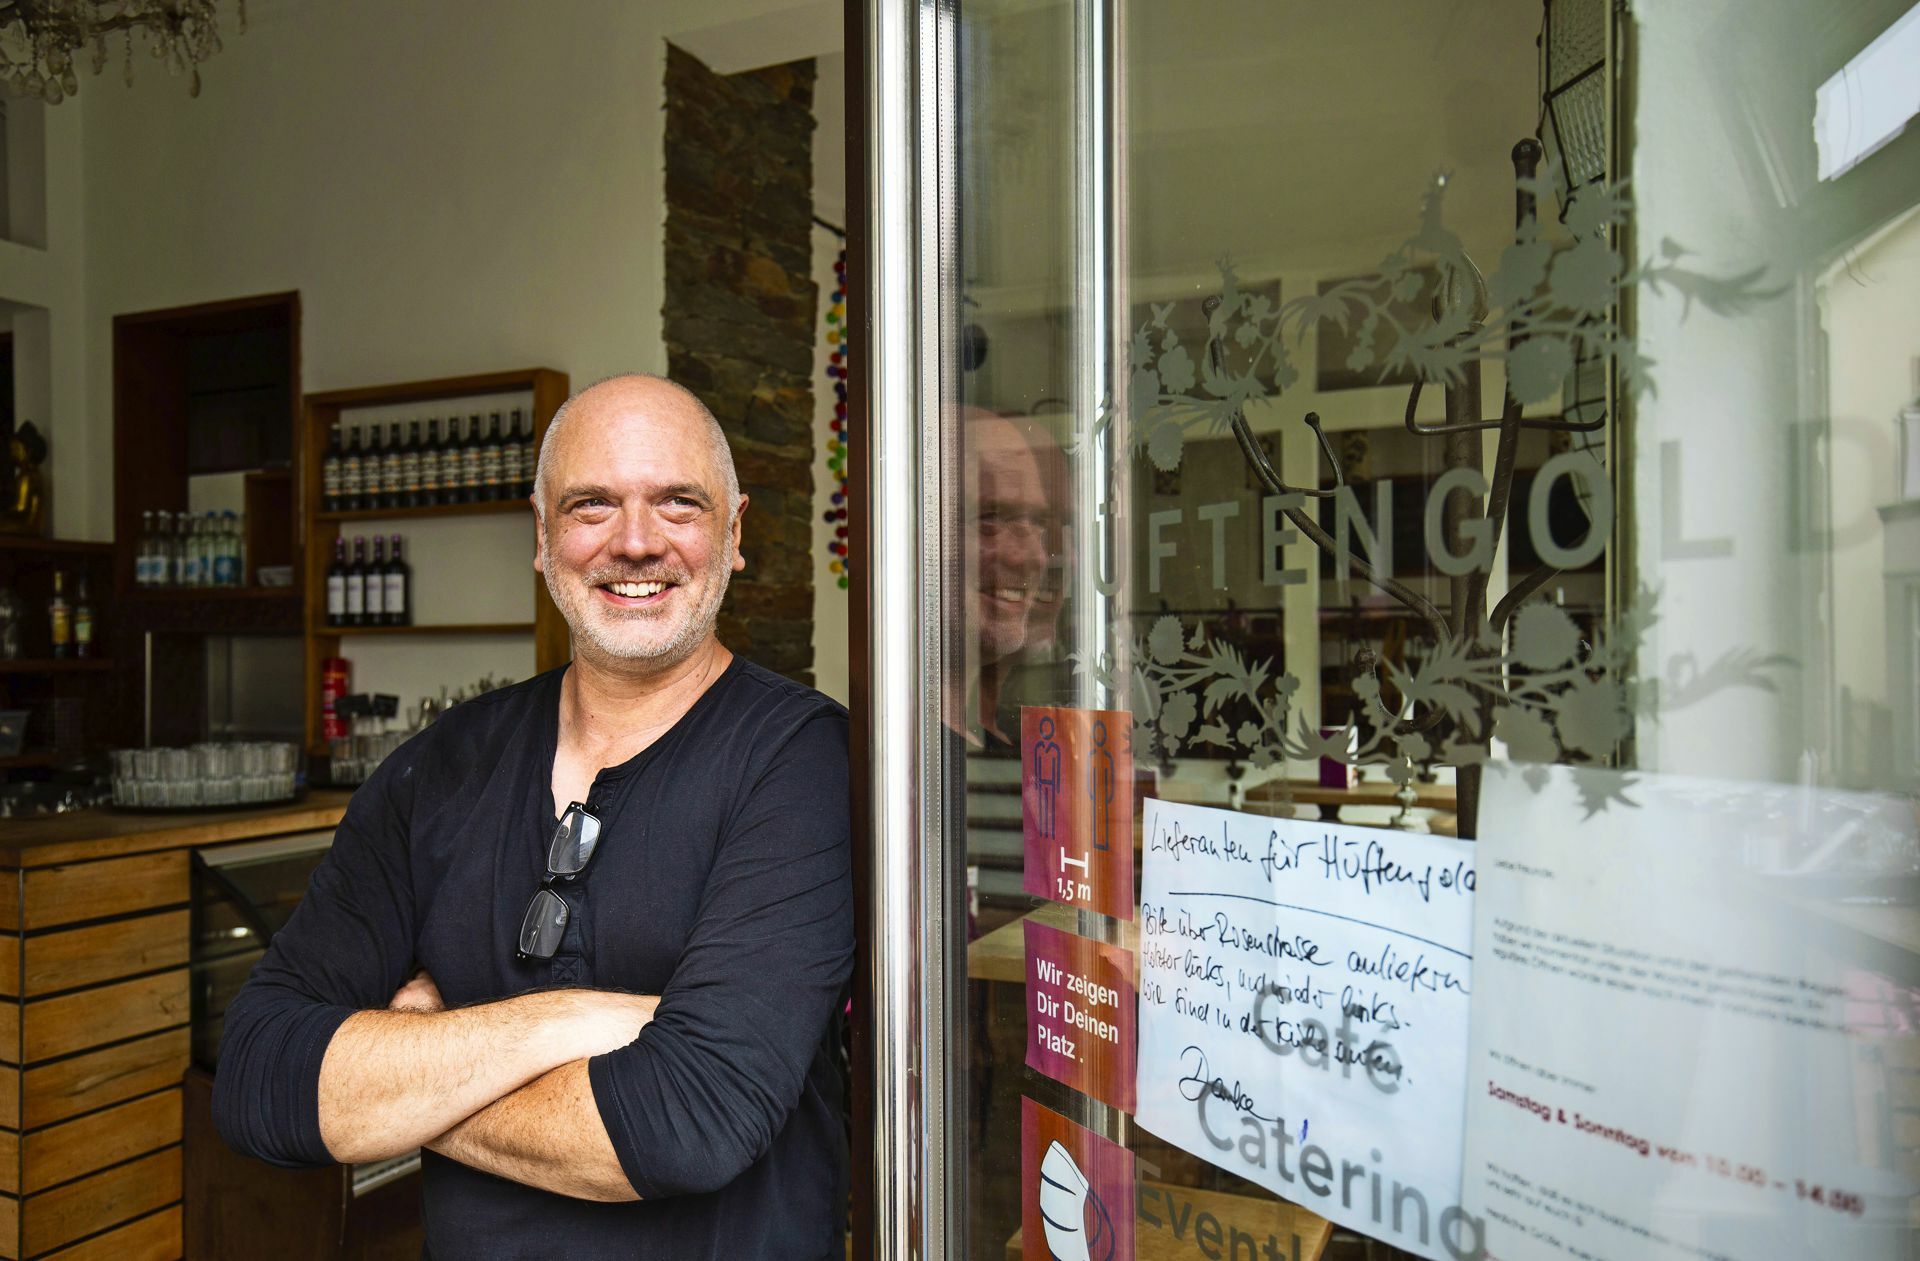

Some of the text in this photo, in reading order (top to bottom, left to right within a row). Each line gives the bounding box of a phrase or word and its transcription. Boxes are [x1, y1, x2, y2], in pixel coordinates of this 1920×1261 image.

[1151, 811, 1252, 861] Lieferanten
[1260, 829, 1317, 883] für
[1057, 877, 1091, 901] 1,5 m
[1036, 957, 1119, 1008] Wir zeigen
[1036, 990, 1119, 1044] Dir Deinen
[1037, 1023, 1076, 1060] Platz
[1253, 983, 1401, 1095] Café
[1488, 1079, 1552, 1123] Samstag
[1574, 1112, 1650, 1156] Sonntag
[1198, 1080, 1486, 1261] Catering
